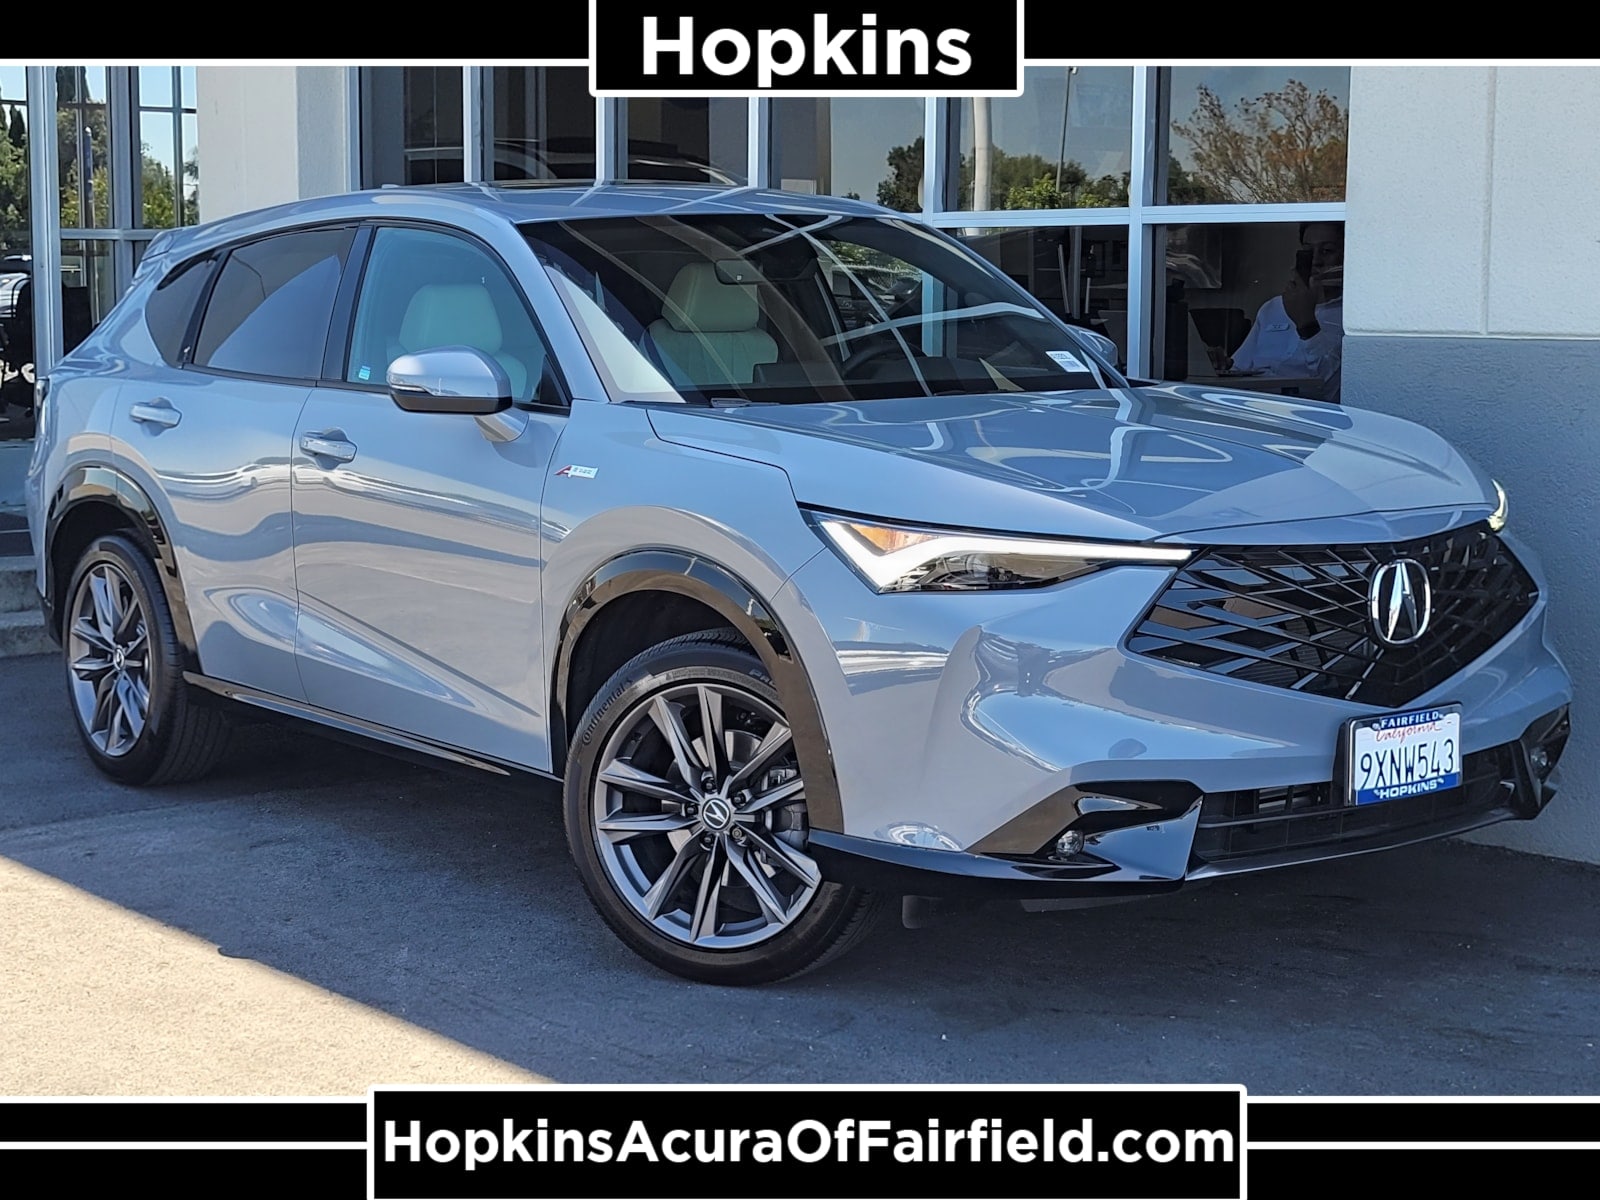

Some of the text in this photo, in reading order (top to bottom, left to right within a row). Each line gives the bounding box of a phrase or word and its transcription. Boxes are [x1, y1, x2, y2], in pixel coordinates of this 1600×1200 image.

[582, 682, 626, 745] Continental
[1381, 711, 1439, 728] FAIRFIELD
[1376, 722, 1443, 744] California
[1360, 738, 1455, 789] 9XNW543
[1380, 780, 1438, 799] HOPKINS
